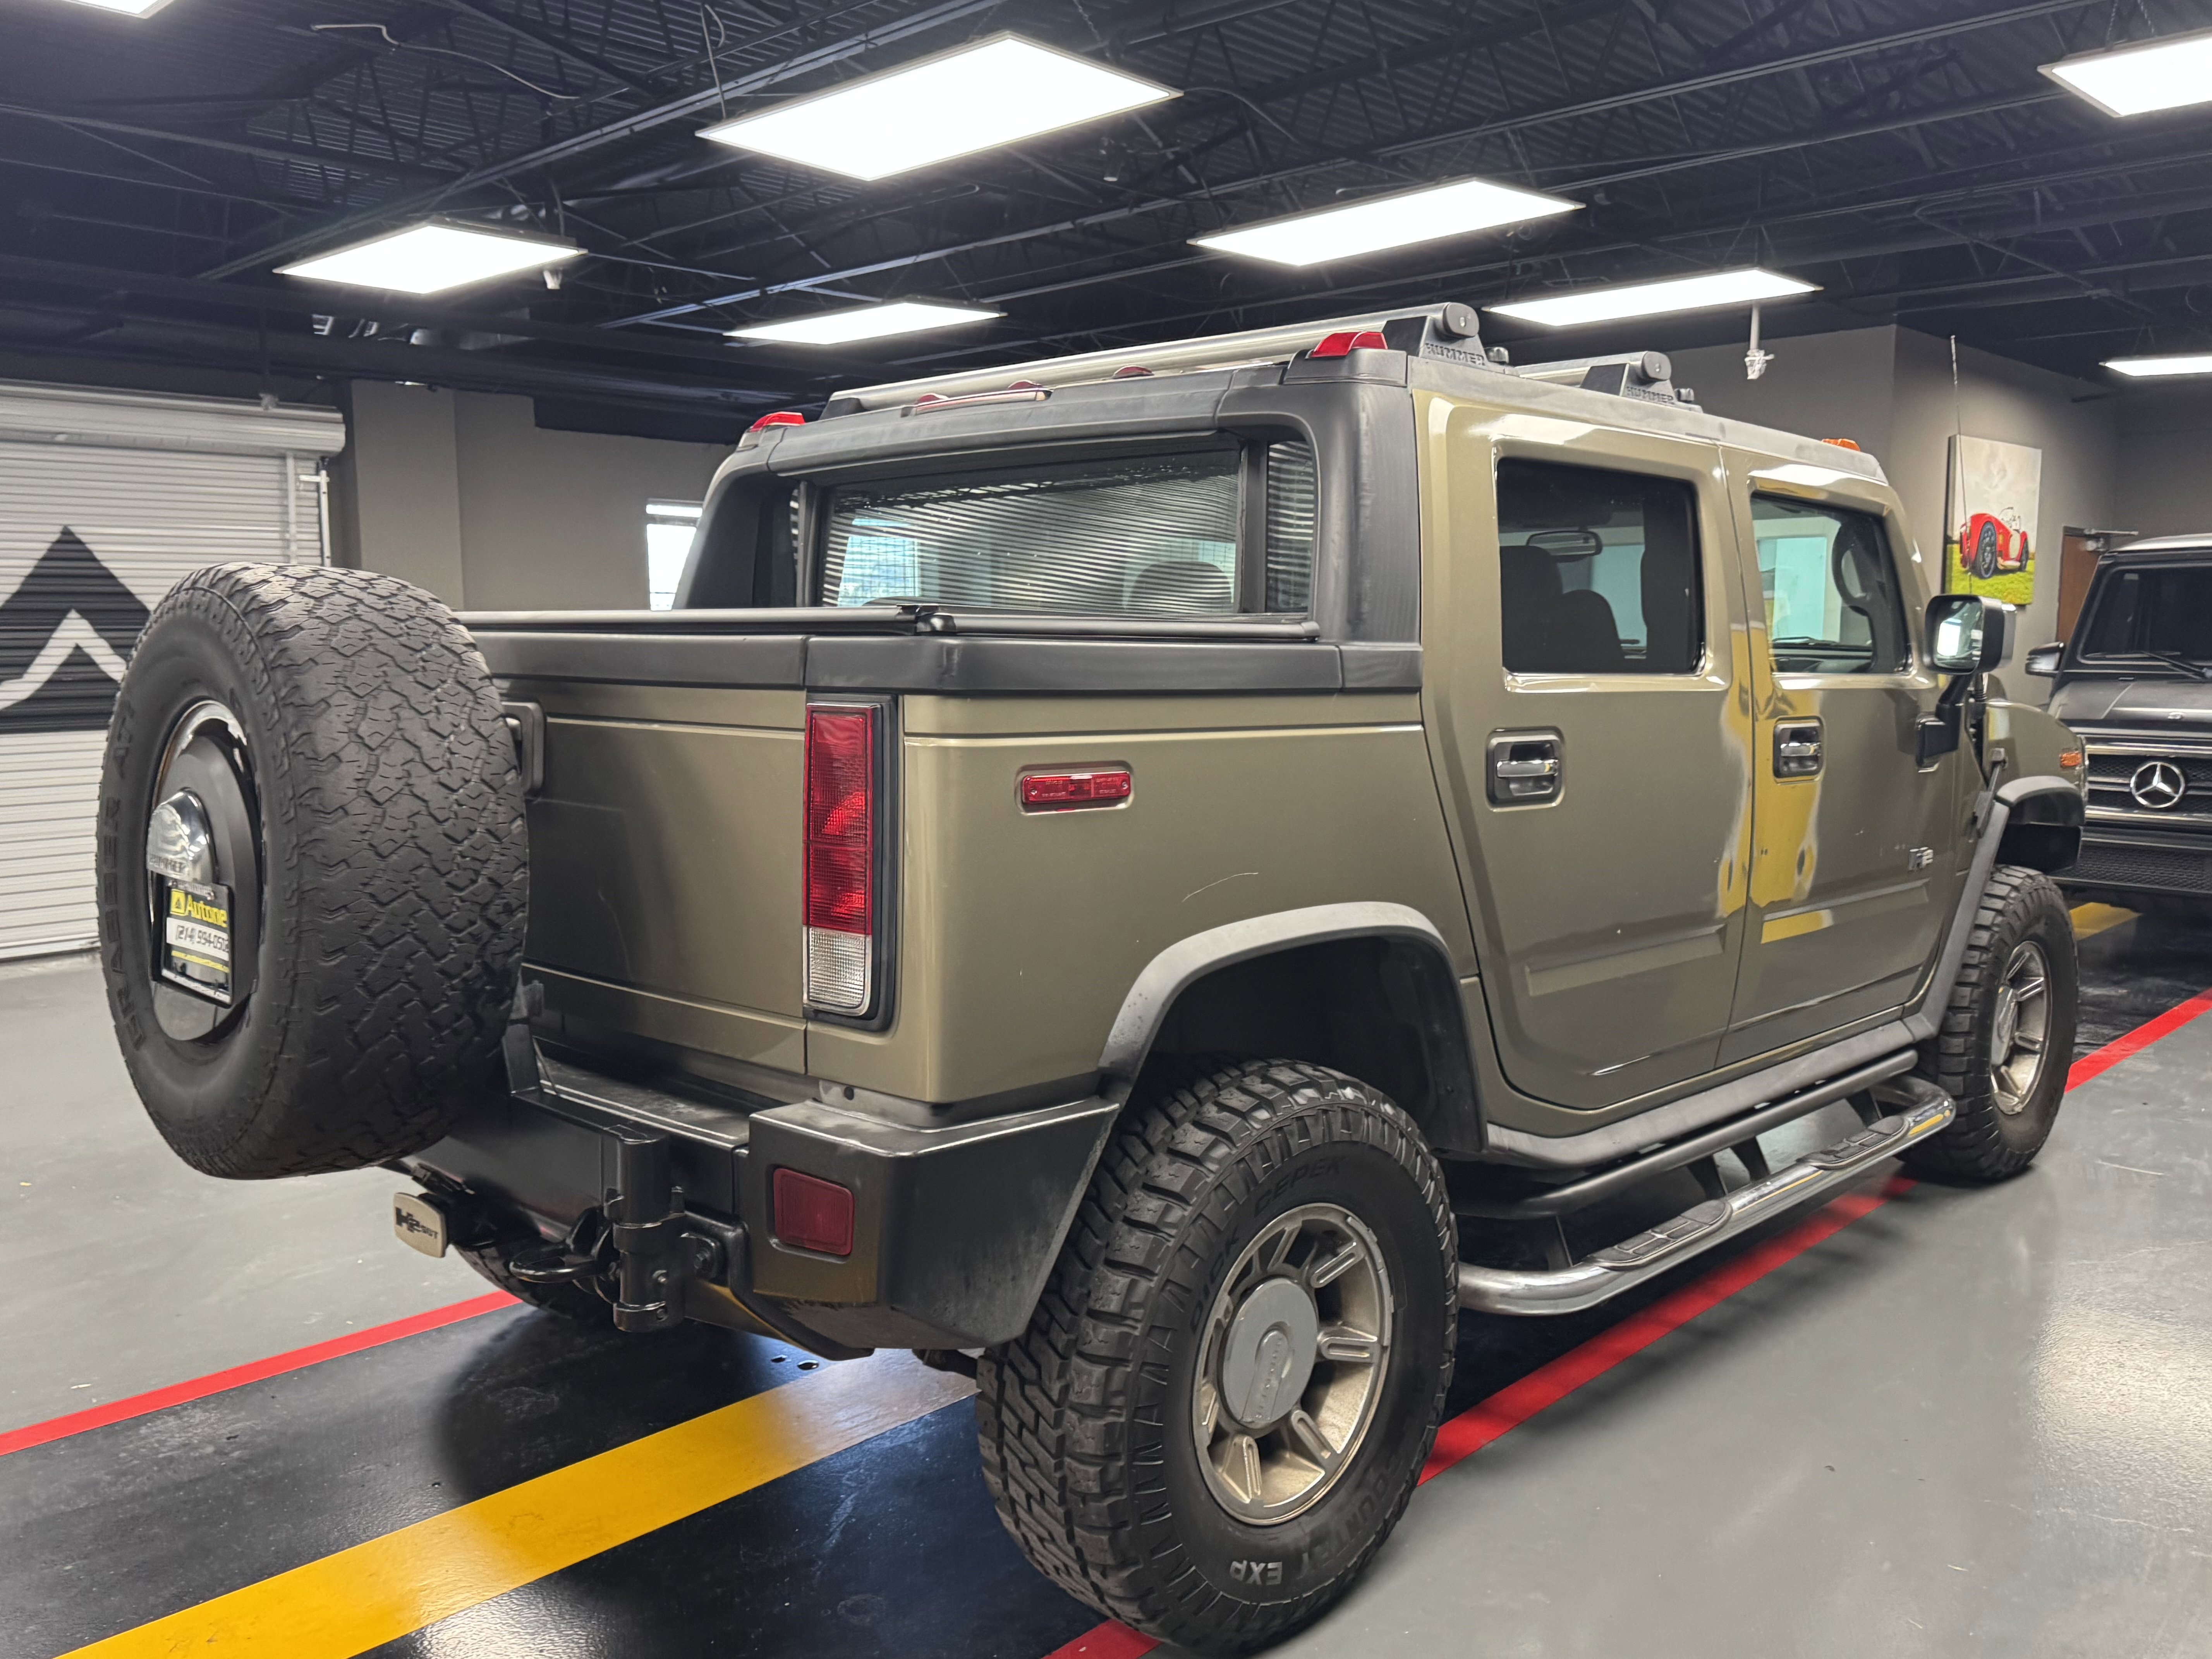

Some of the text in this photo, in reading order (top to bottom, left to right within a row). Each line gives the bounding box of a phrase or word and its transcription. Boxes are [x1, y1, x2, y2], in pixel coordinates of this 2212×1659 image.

[1425, 343, 1486, 366] HUMMER
[1626, 386, 1675, 405] HUMMER
[1190, 1156, 1345, 1335] DICK CEPEK
[1230, 1559, 1283, 1585] EXP
